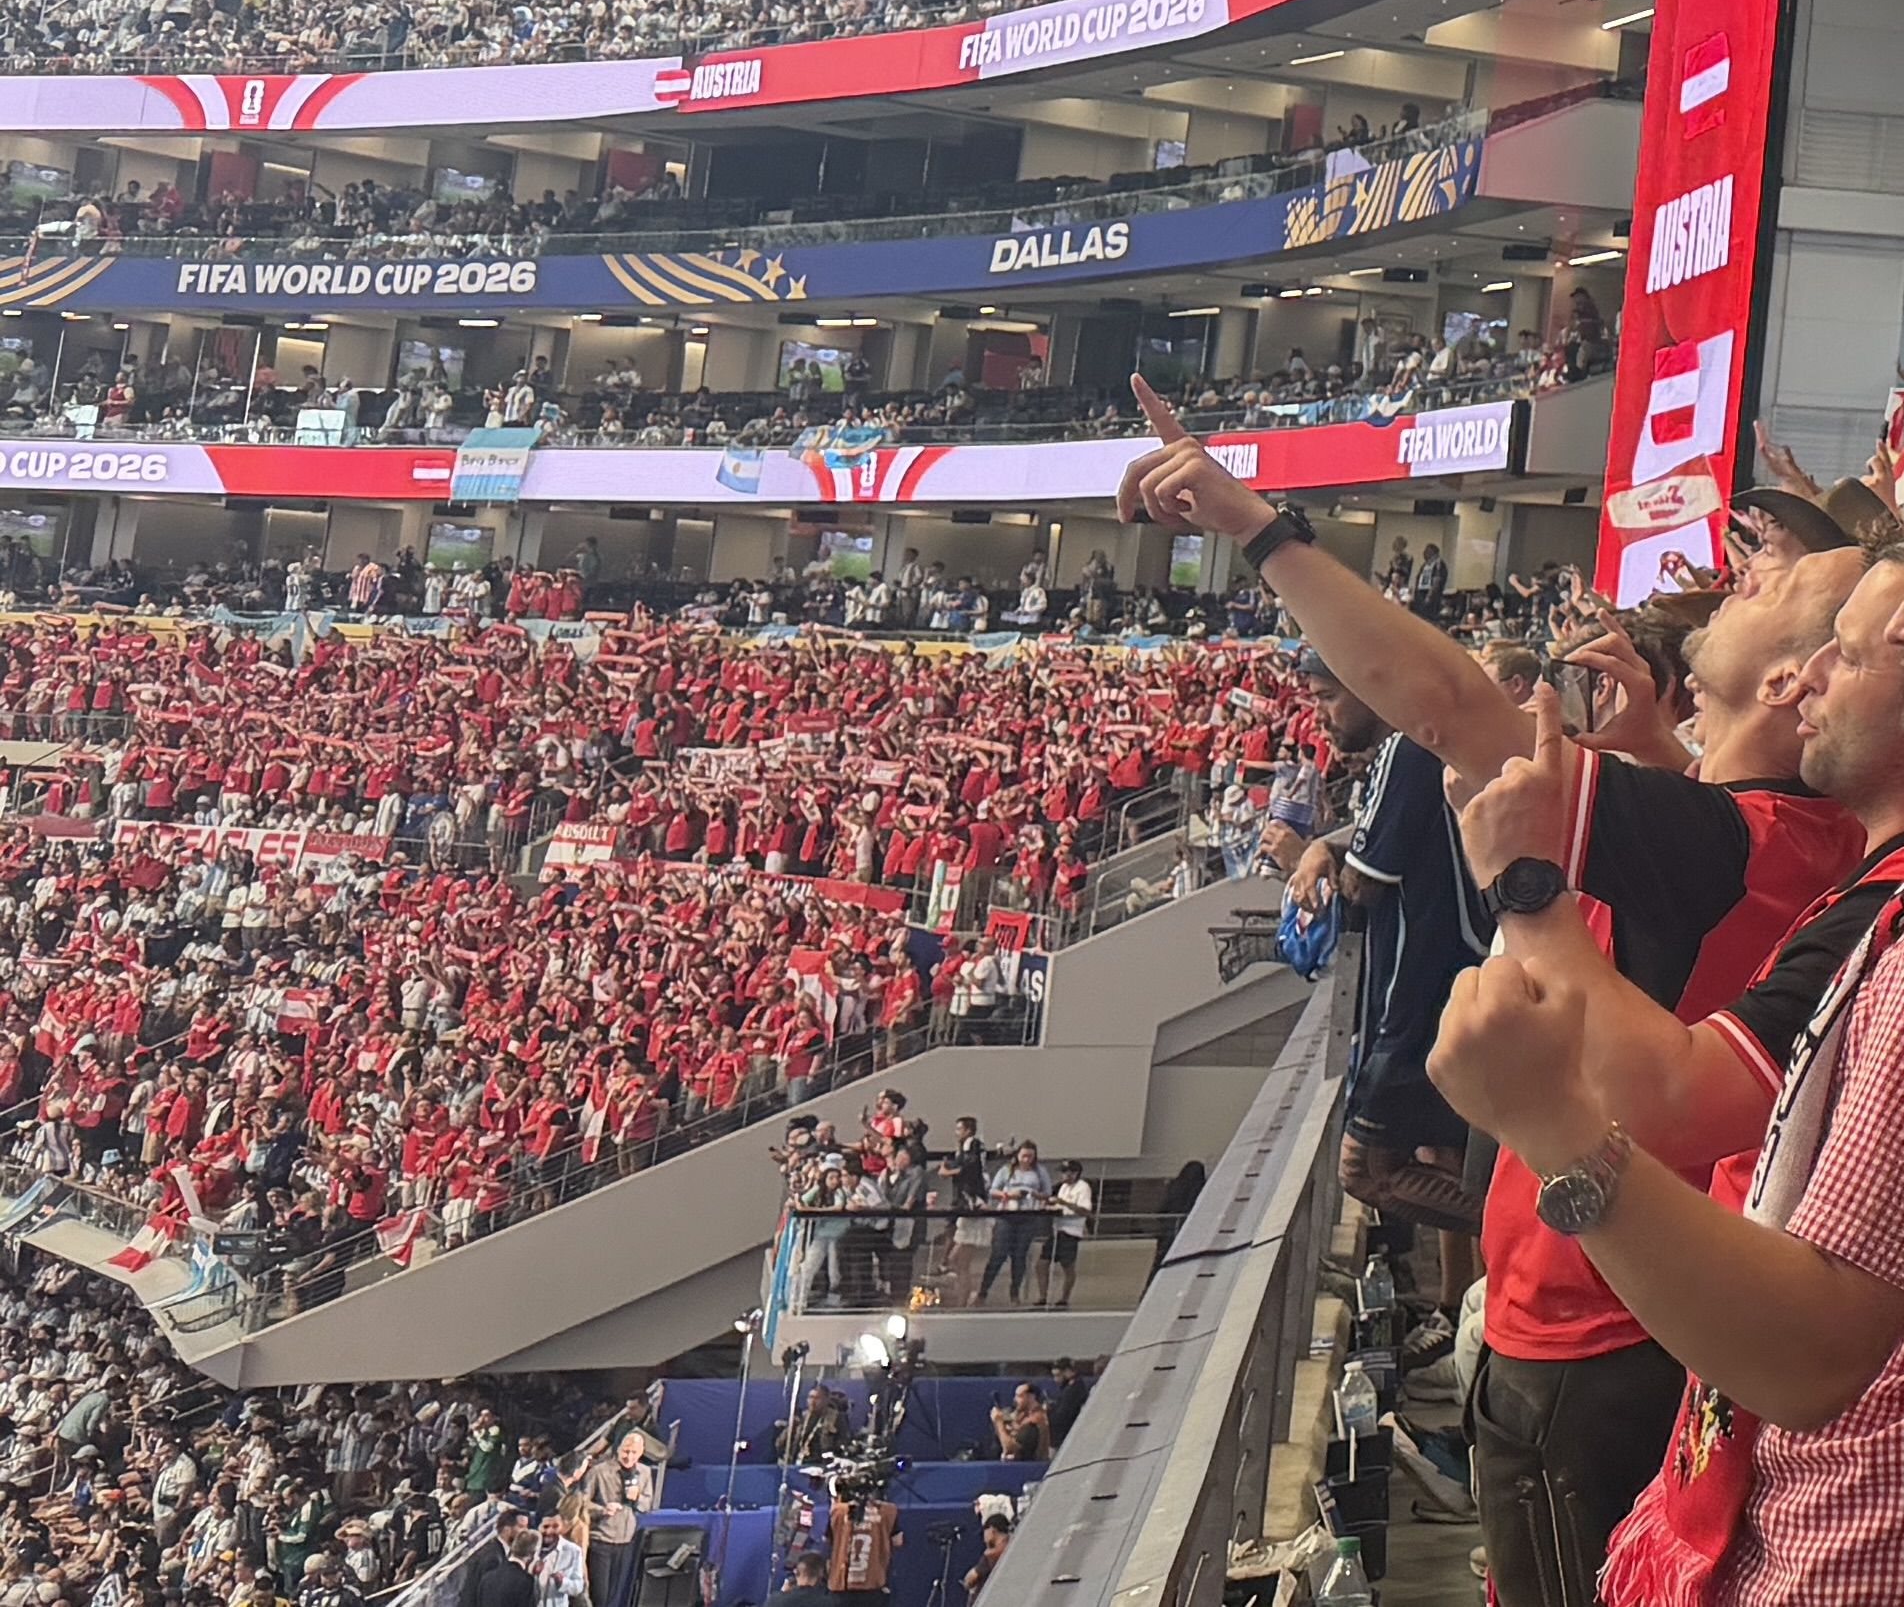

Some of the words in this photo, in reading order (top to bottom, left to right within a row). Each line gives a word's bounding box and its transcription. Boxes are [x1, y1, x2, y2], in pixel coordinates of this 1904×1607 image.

[959, 29, 1002, 70] FIFA
[1003, 12, 1080, 59] WORLD
[1082, 2, 1128, 44] CUP
[690, 59, 761, 101] AUSTRIA
[988, 222, 1130, 274] DALLAS
[1645, 172, 1735, 296] AUSTRIA
[176, 264, 247, 293] FIFA
[254, 264, 371, 294] WORLD
[374, 264, 433, 294] CUP
[433, 262, 537, 293] 2026
[1397, 428, 1434, 464] FIFA
[1436, 418, 1498, 459] WORLD
[10, 451, 67, 478] CUP
[68, 453, 168, 482] 2026
